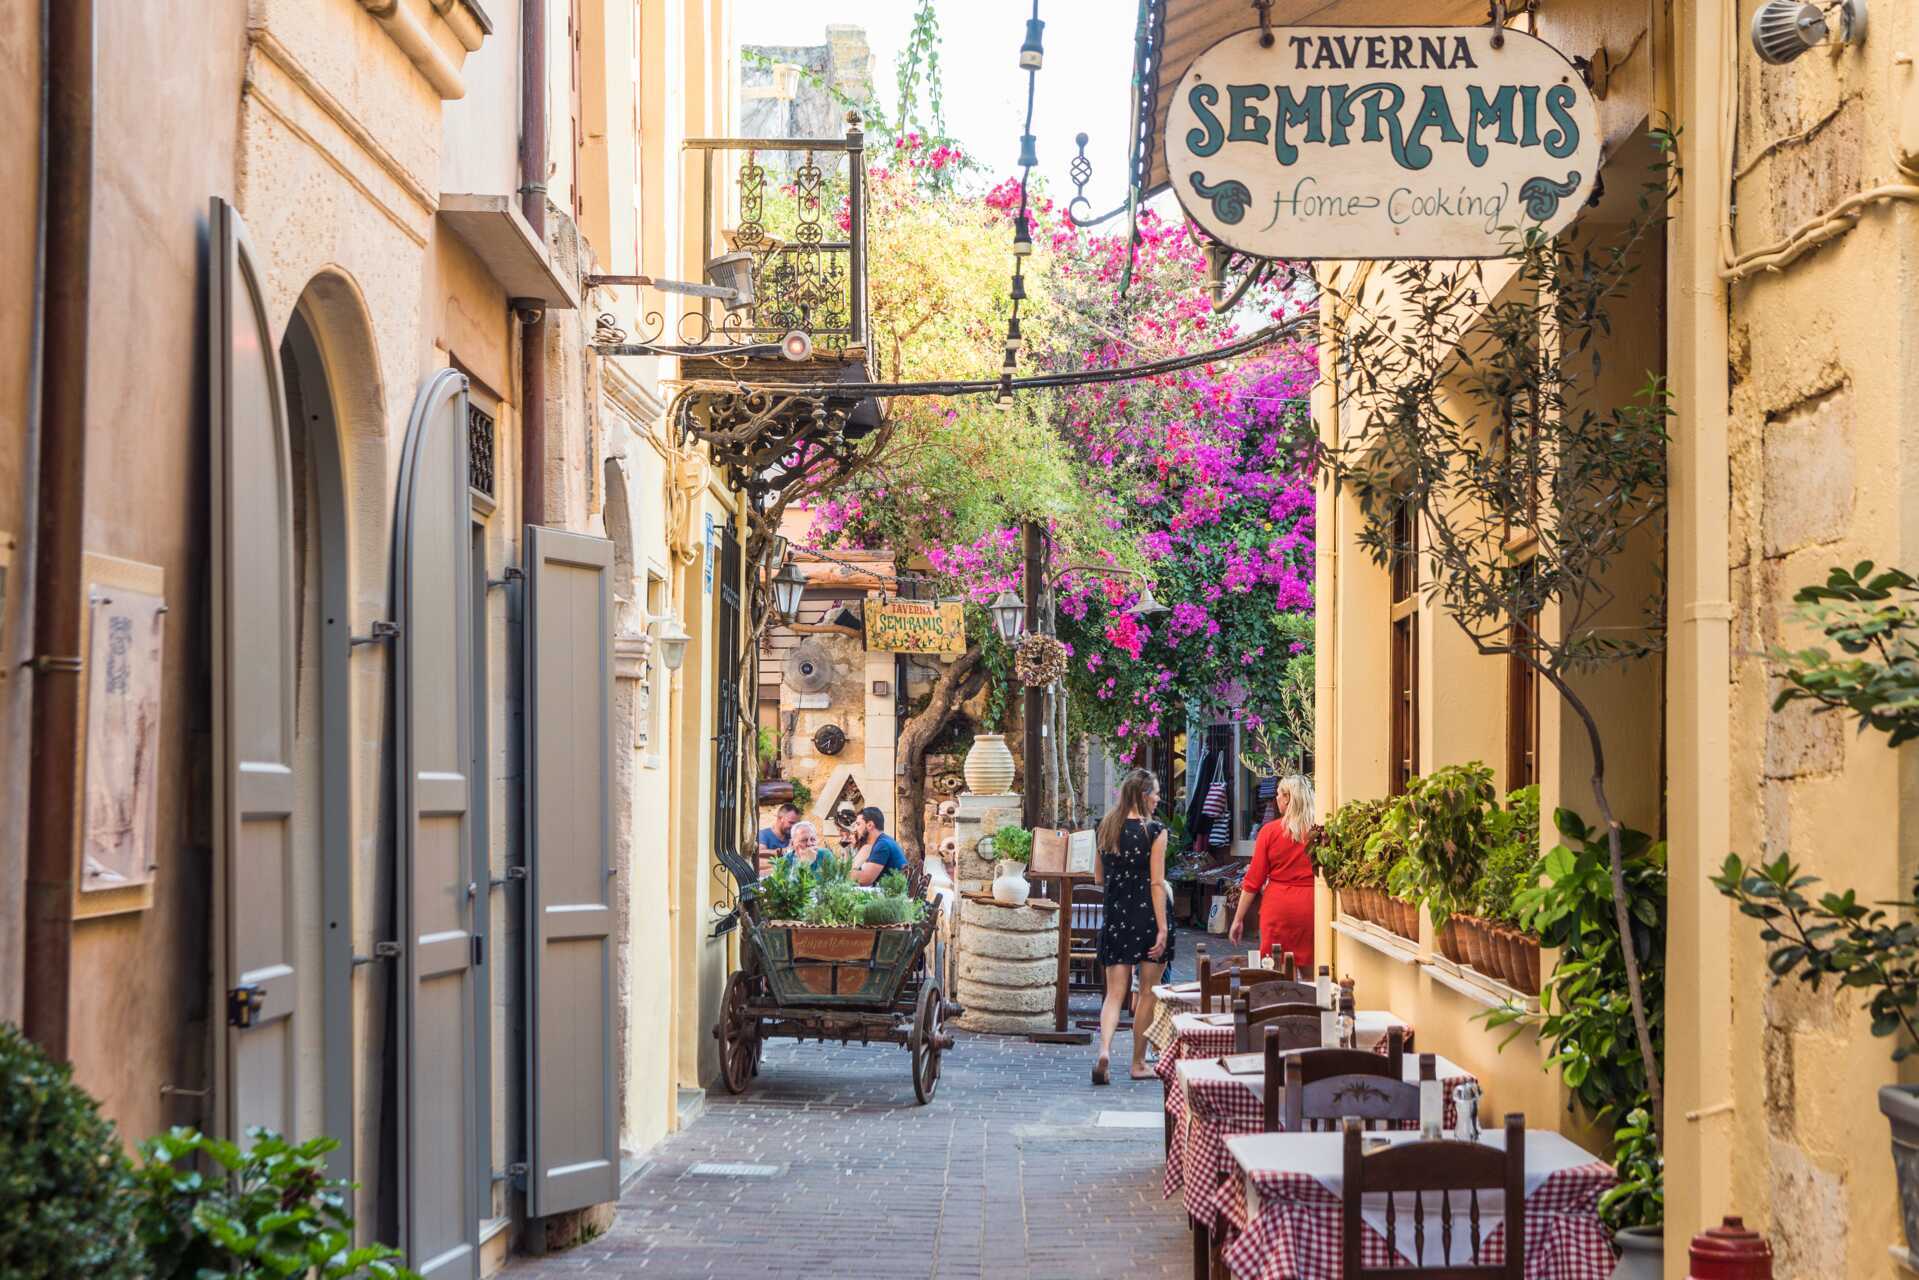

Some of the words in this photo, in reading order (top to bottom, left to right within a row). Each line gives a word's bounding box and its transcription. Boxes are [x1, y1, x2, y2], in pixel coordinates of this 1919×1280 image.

[1289, 35, 1478, 69] TAVERNA
[1186, 82, 1580, 170] SEMIRAMIS
[1259, 176, 1380, 232] Home
[1388, 182, 1509, 233] Cooking
[880, 614, 943, 635] SEMIRAMIS
[892, 604, 932, 615] TAVERNA
